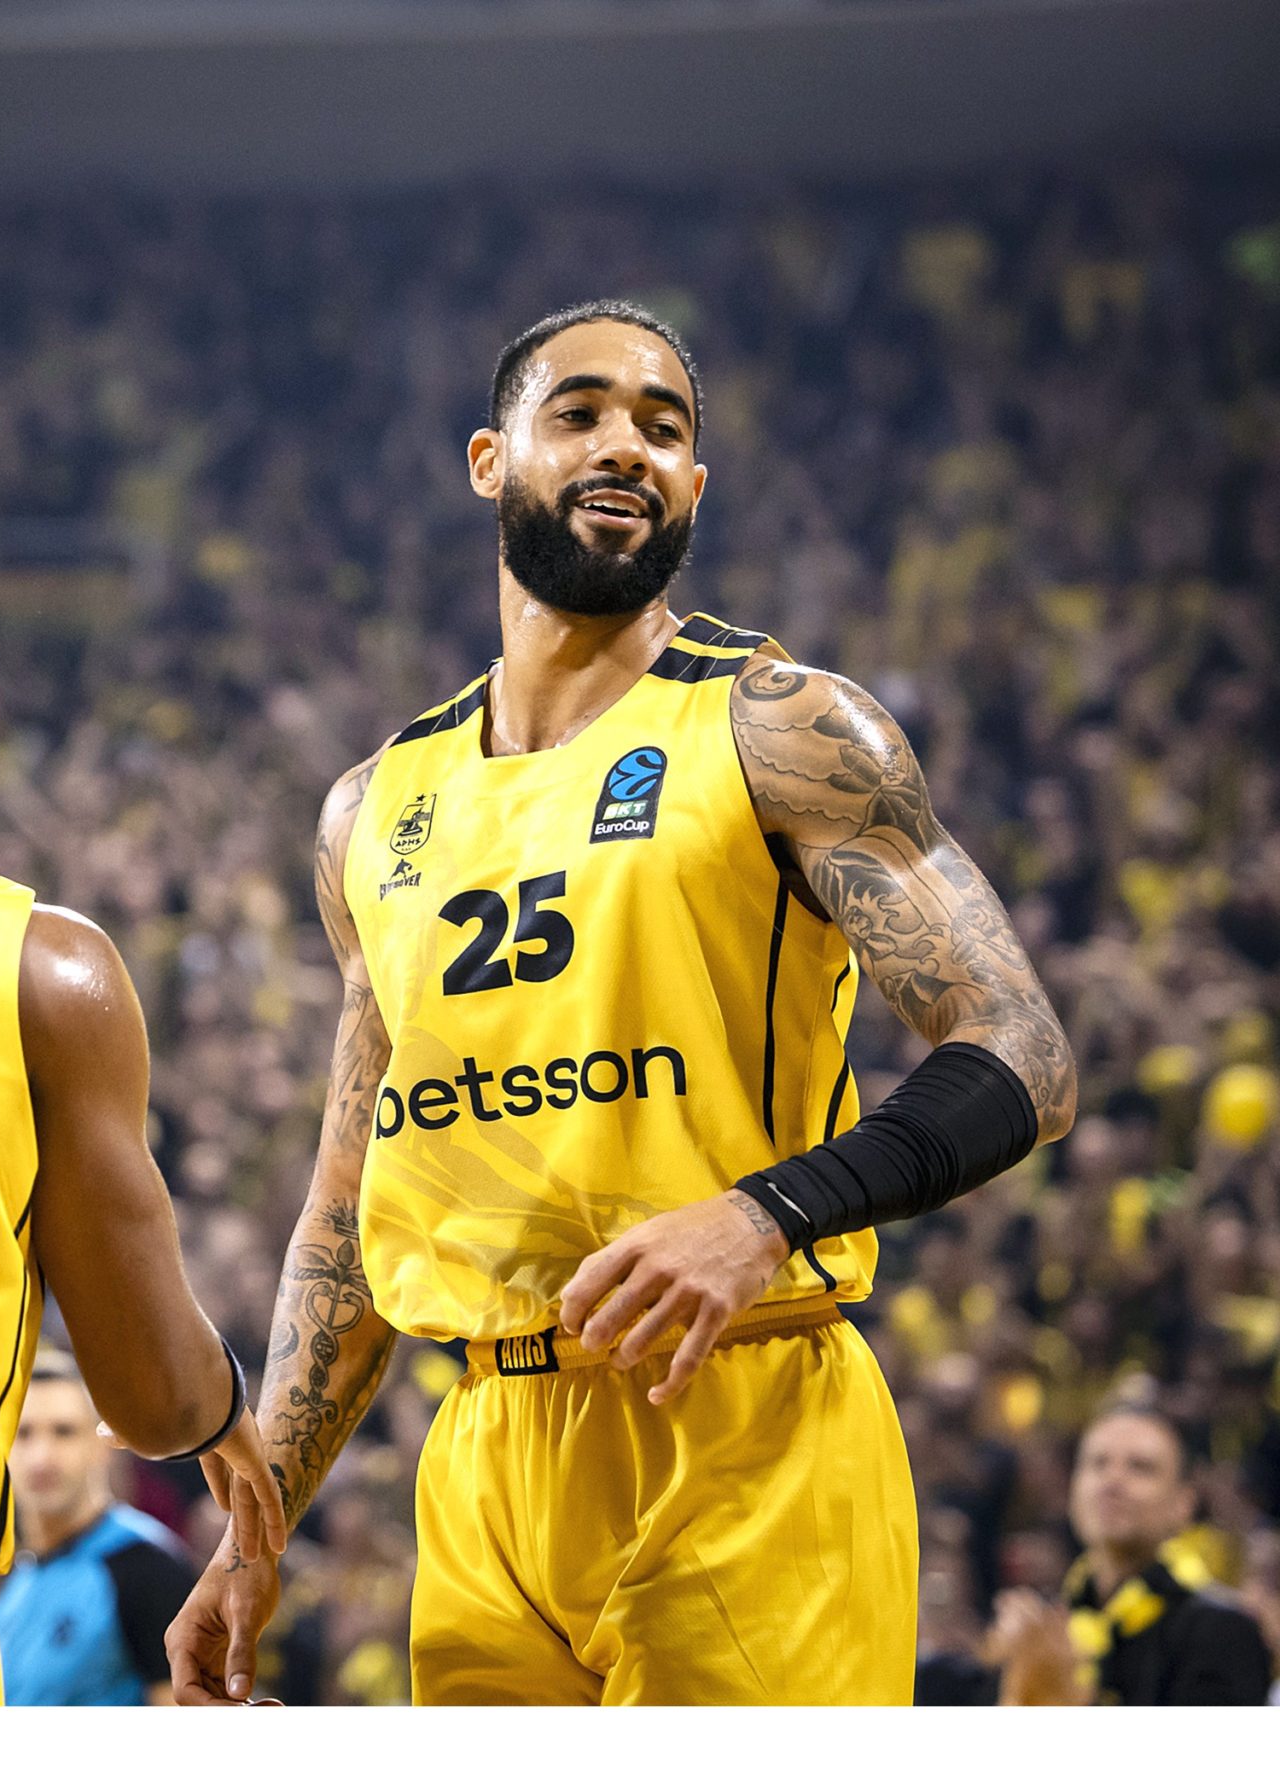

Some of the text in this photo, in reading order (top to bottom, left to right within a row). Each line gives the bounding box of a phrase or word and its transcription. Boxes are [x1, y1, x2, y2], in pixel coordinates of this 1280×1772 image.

[594, 819, 650, 835] EuroCup
[438, 870, 575, 996] 25
[501, 1333, 547, 1369] ARIS
